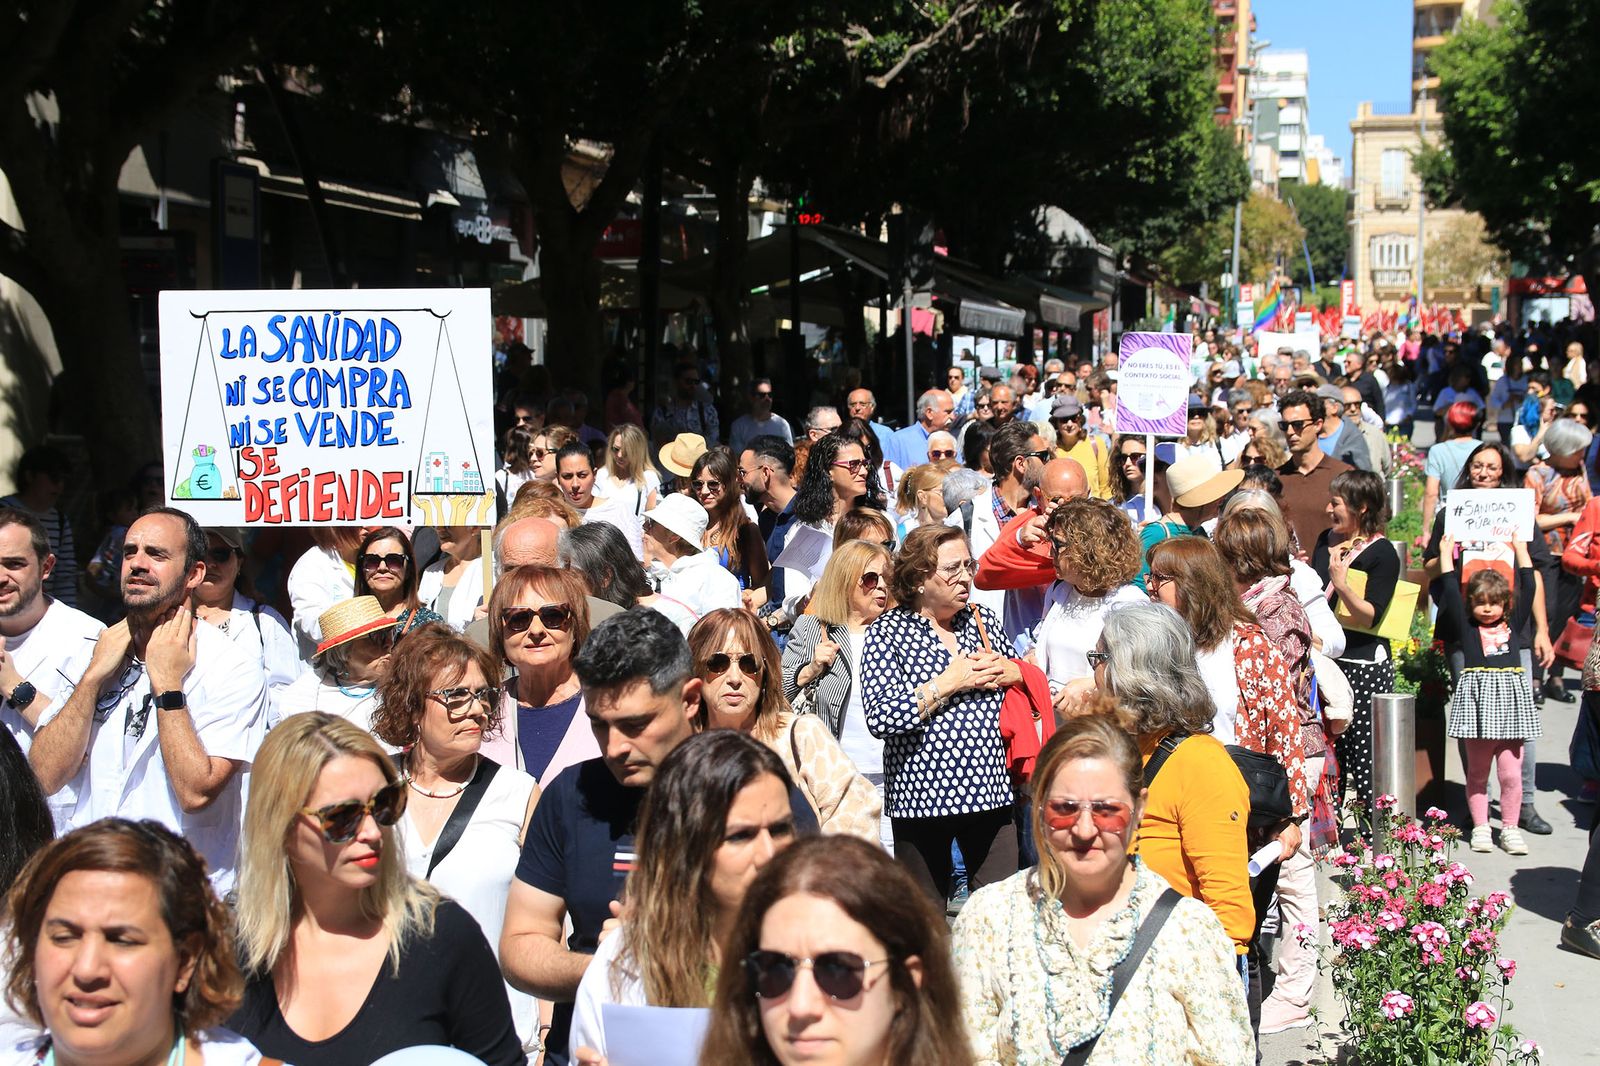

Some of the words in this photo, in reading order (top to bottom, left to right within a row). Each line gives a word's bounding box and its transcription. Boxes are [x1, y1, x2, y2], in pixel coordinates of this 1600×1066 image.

[220, 324, 257, 359] LA
[252, 376, 286, 405] SE
[289, 367, 412, 409] COMPRA
[254, 416, 288, 446] SE
[1452, 500, 1517, 518] #SANIDAD
